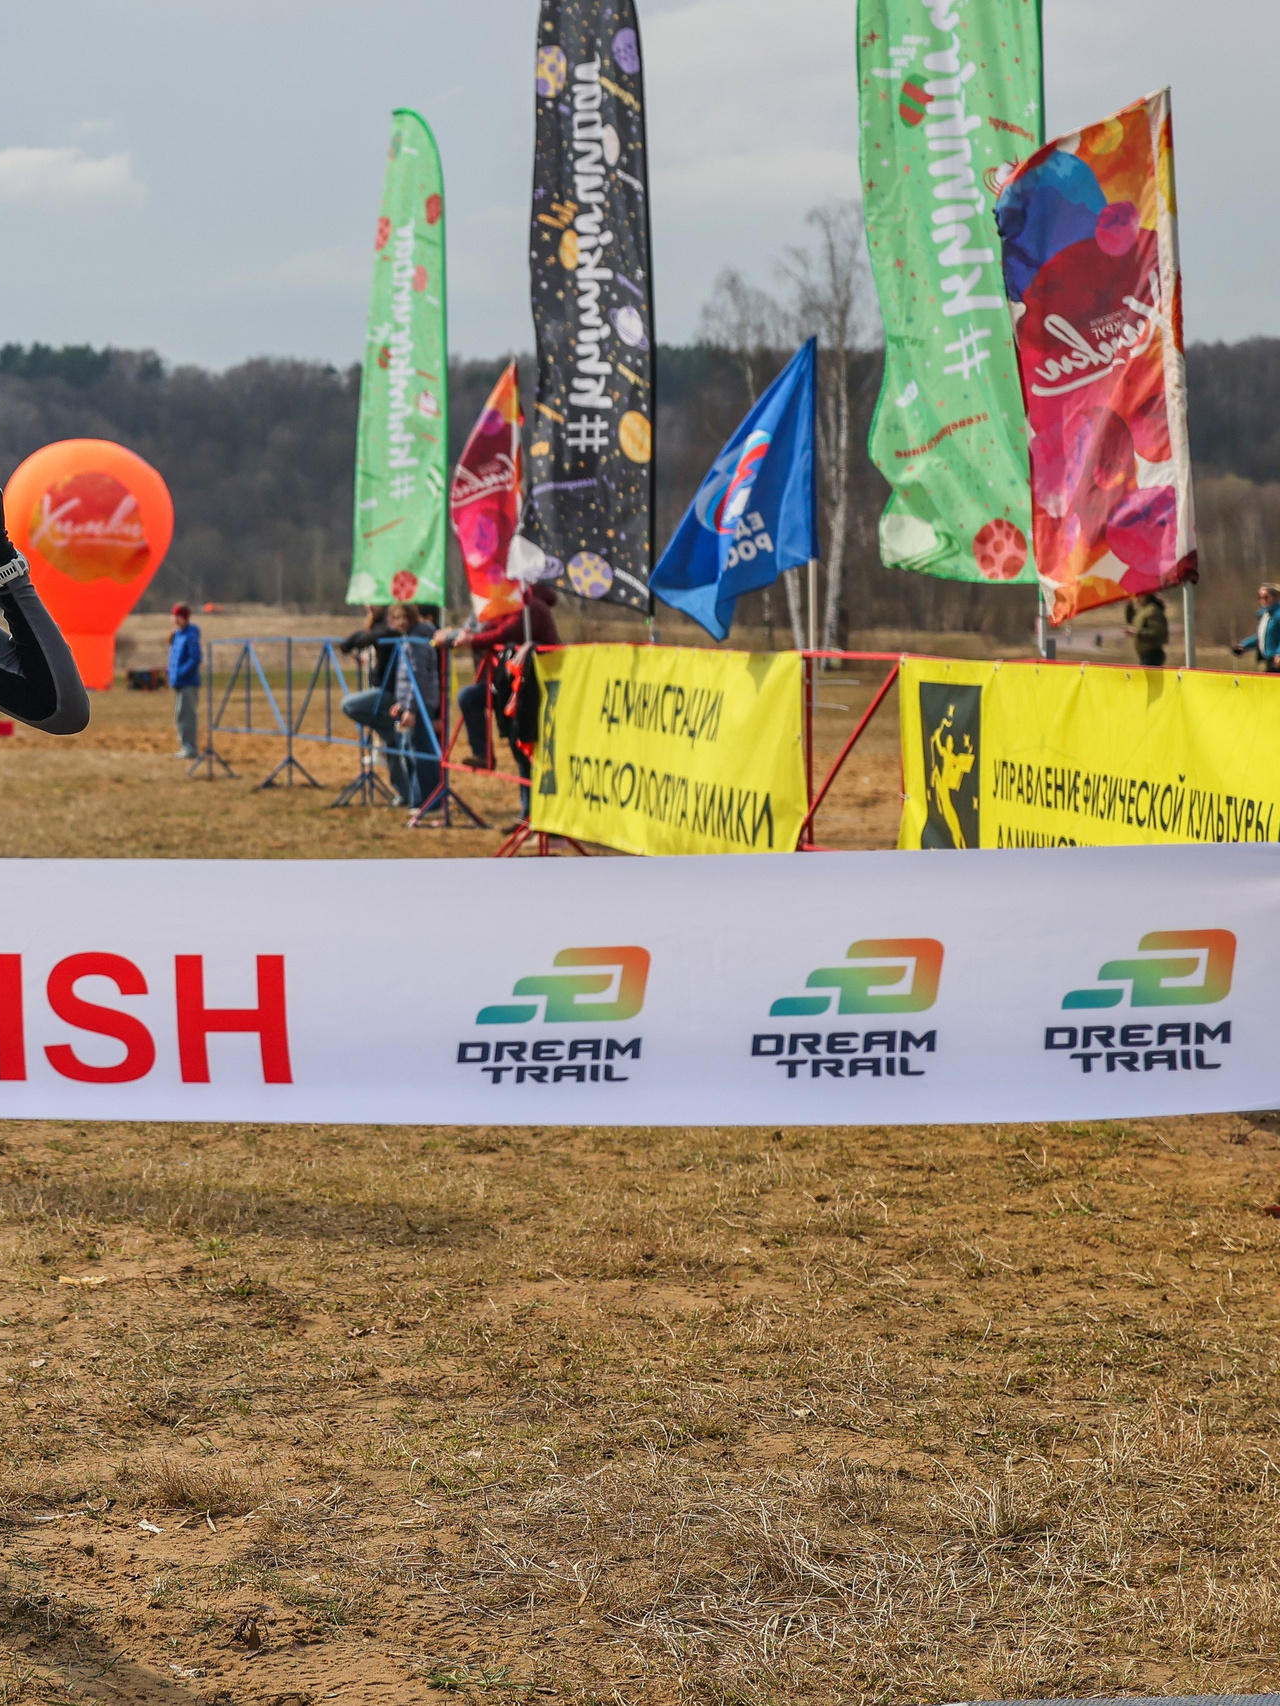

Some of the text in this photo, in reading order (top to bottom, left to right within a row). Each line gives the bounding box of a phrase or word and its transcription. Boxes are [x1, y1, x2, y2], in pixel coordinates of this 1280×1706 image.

[692, 781, 774, 849] ХИМКИ
[1082, 773, 1186, 836] ФИЗИЧЕСКОЙ
[1186, 788, 1275, 843] КУЛЬТУРЫ
[751, 1029, 937, 1056] DREAM
[1044, 1020, 1232, 1050] DREAM
[456, 1037, 642, 1064] DREAM
[1069, 1048, 1223, 1074] TRAIL
[480, 1063, 629, 1085] TRAIL
[776, 1056, 926, 1079] TRAIL
